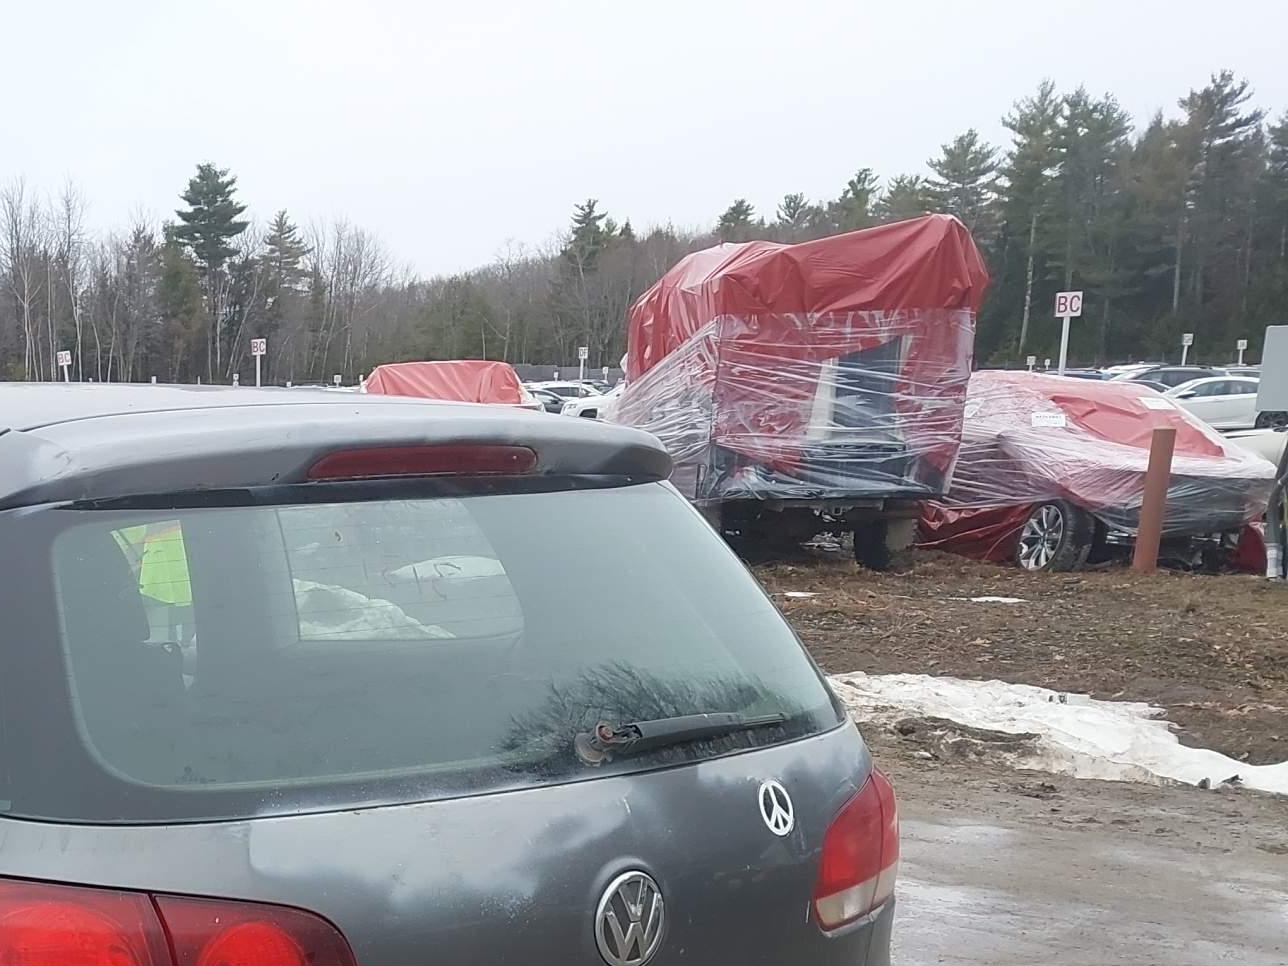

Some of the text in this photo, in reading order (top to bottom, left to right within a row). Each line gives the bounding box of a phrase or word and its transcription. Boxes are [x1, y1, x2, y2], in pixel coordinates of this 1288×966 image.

[1057, 295, 1081, 313] BC
[252, 341, 265, 353] BC
[57, 352, 70, 364] BC
[598, 873, 663, 964] VW
